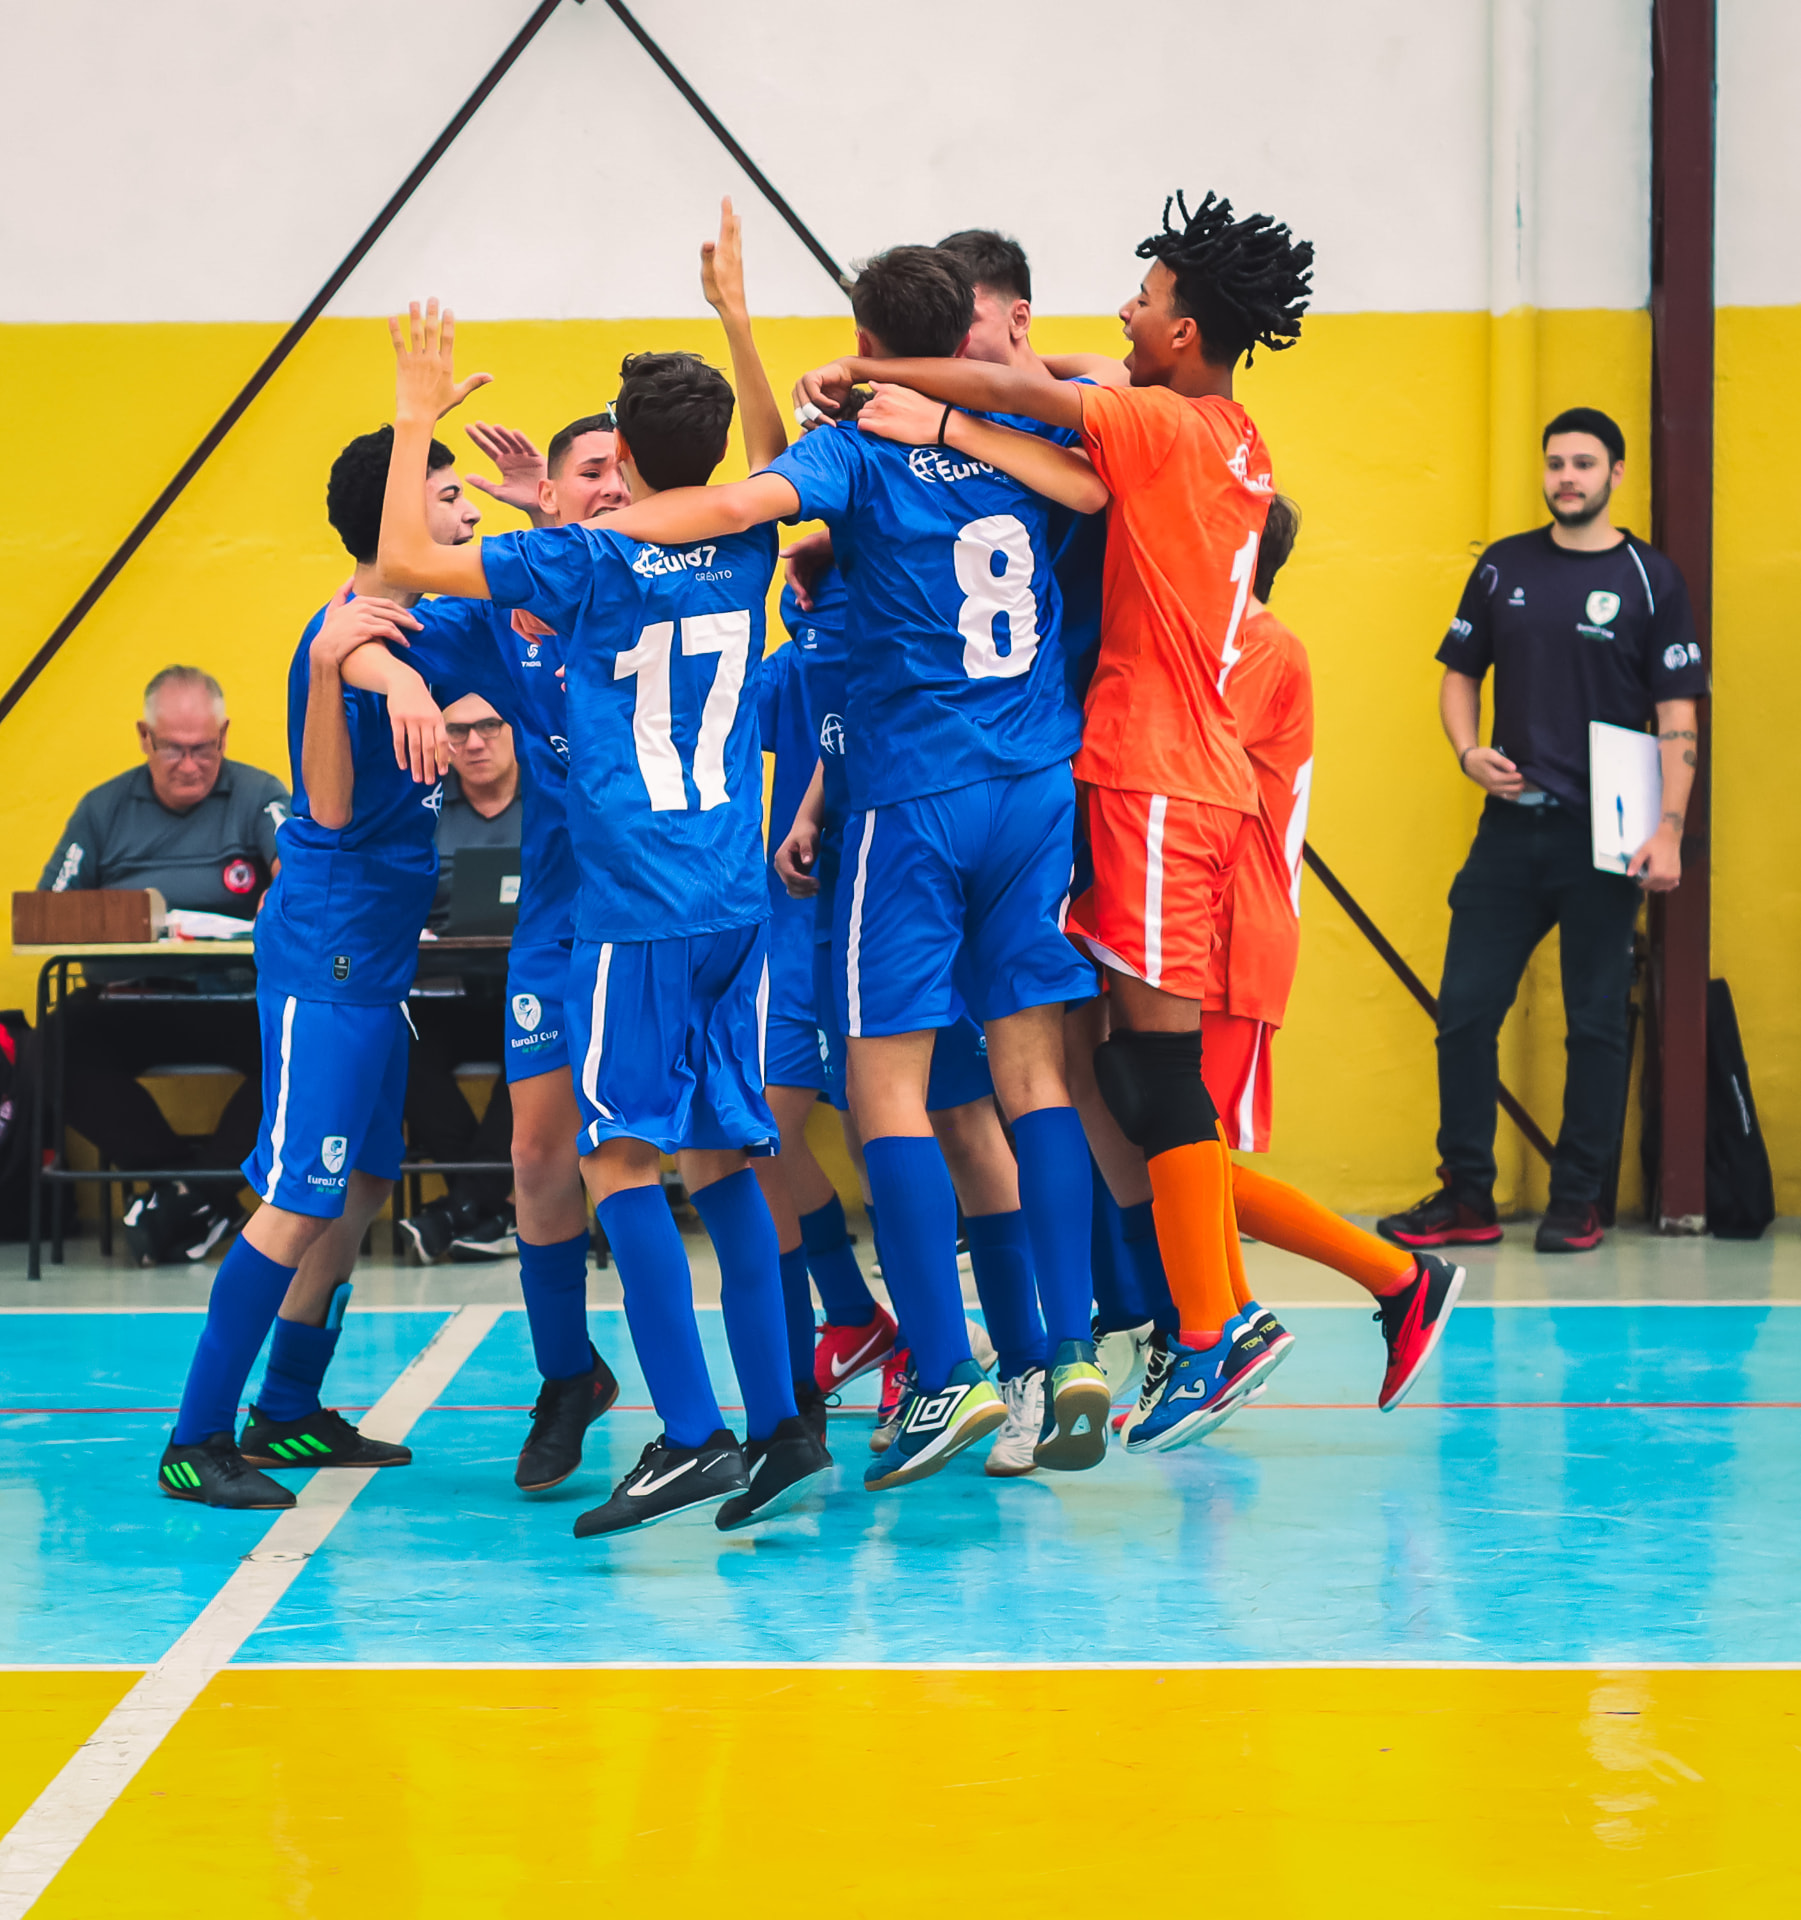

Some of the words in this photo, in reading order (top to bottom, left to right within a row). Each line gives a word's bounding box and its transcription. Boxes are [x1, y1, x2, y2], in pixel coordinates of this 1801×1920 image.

[954, 515, 1040, 679] 8
[614, 609, 751, 811] 17
[511, 1033, 538, 1048] Euro17
[540, 1029, 559, 1042] Cup
